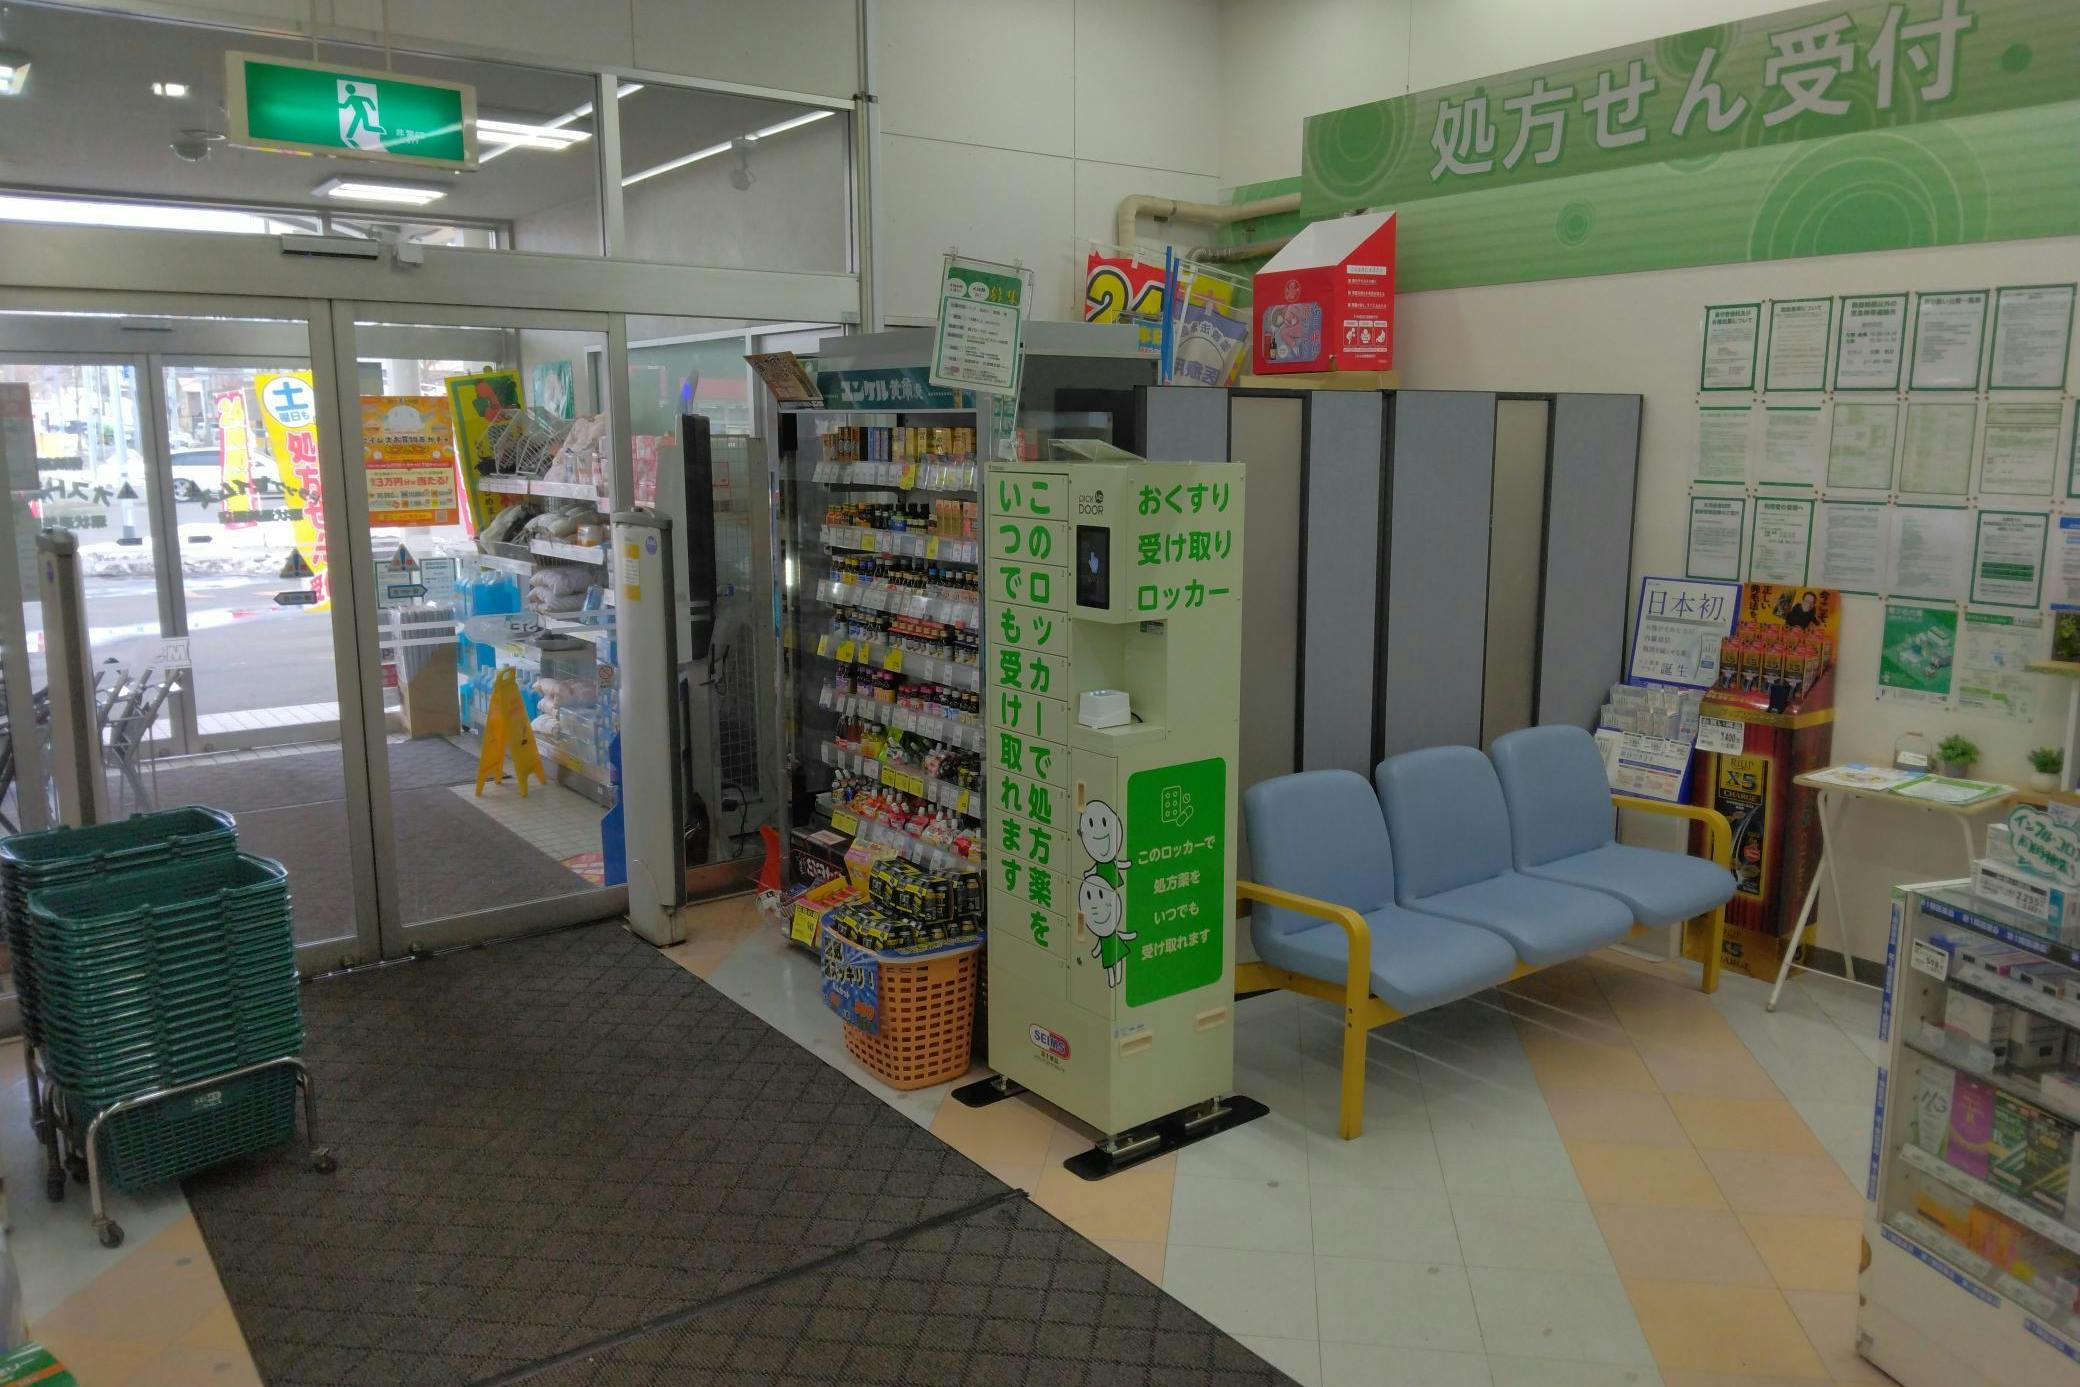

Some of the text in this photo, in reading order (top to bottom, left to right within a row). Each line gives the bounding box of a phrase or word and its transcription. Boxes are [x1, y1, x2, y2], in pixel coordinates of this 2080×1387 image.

[1429, 0, 1976, 184] 処方せん受付
[1078, 503, 1104, 515] DOOR
[1138, 482, 1230, 516] おくすり
[1137, 529, 1232, 566] 受け取り
[1137, 578, 1230, 611] ロッカー
[998, 479, 1023, 893] いつでも受け取れます
[1028, 480, 1052, 948] このロッカーで処方薬を
[1137, 835, 1217, 866] このロッカーで
[1153, 870, 1201, 895] 処方薬を
[1153, 902, 1200, 926] いつでも
[1140, 928, 1211, 961] 受け取れます
[1033, 1029, 1066, 1053] SEIMS
